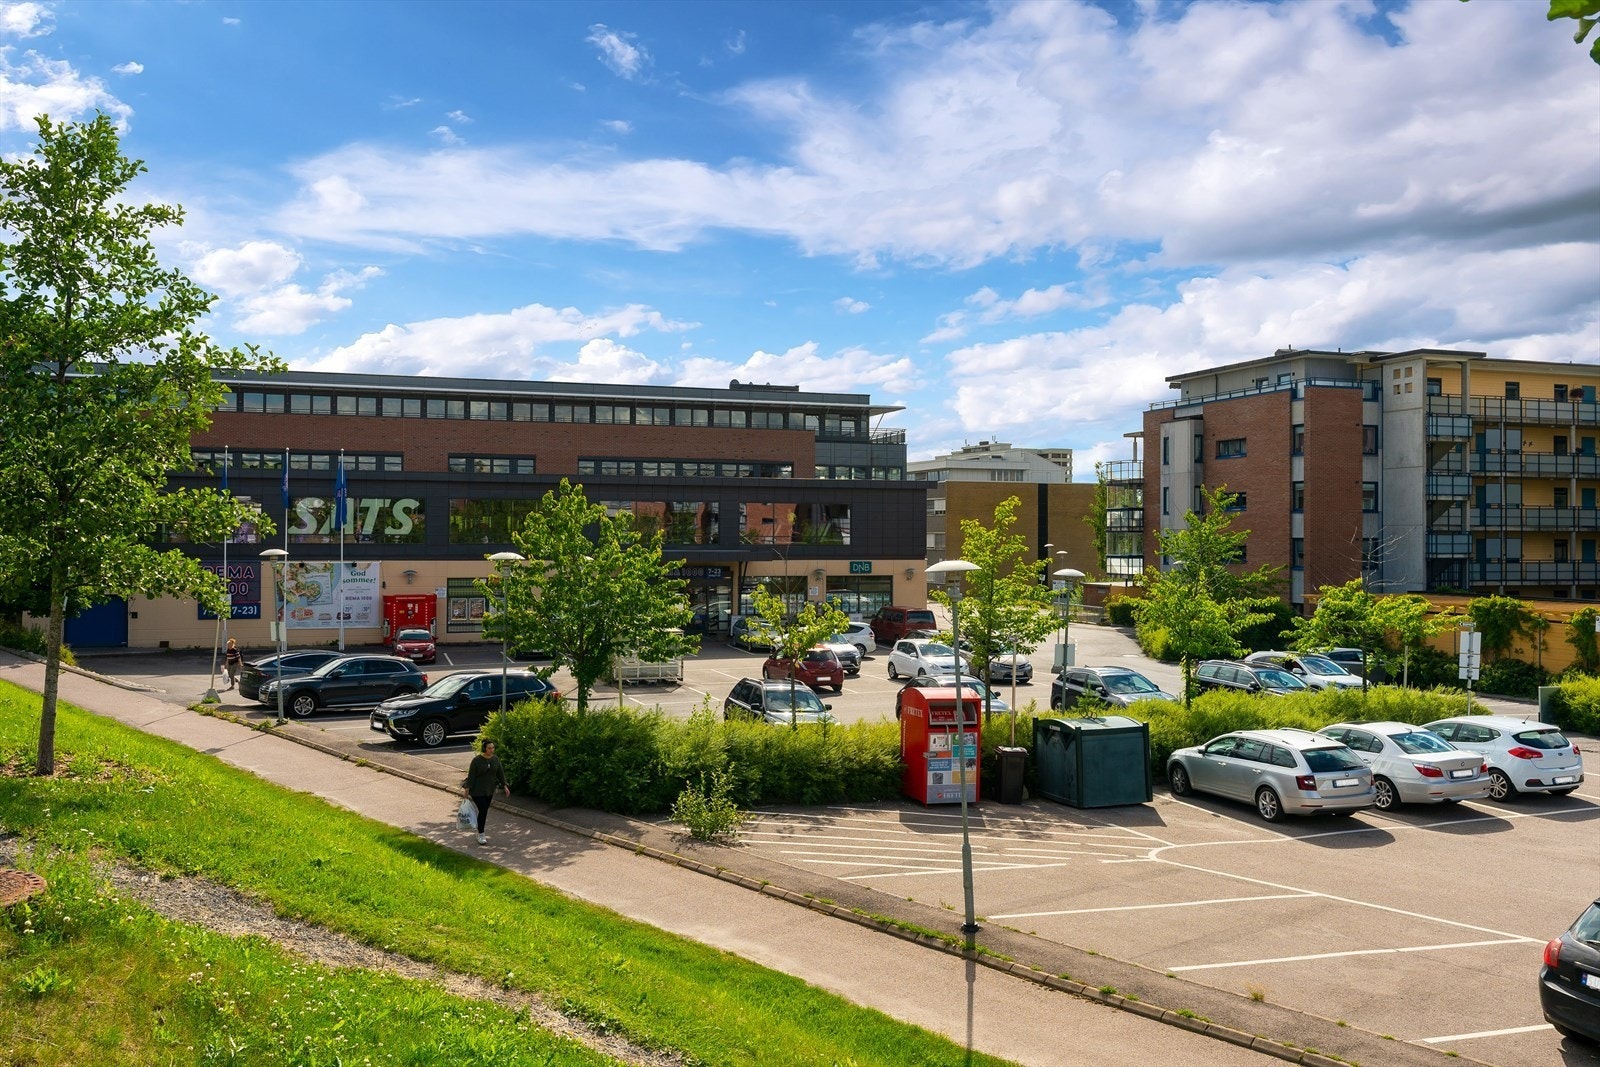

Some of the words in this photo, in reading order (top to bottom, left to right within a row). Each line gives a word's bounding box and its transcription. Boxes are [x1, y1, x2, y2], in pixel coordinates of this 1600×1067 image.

[288, 497, 420, 535] SATS
[853, 561, 870, 574] DNB
[907, 706, 923, 718] FRETEX
